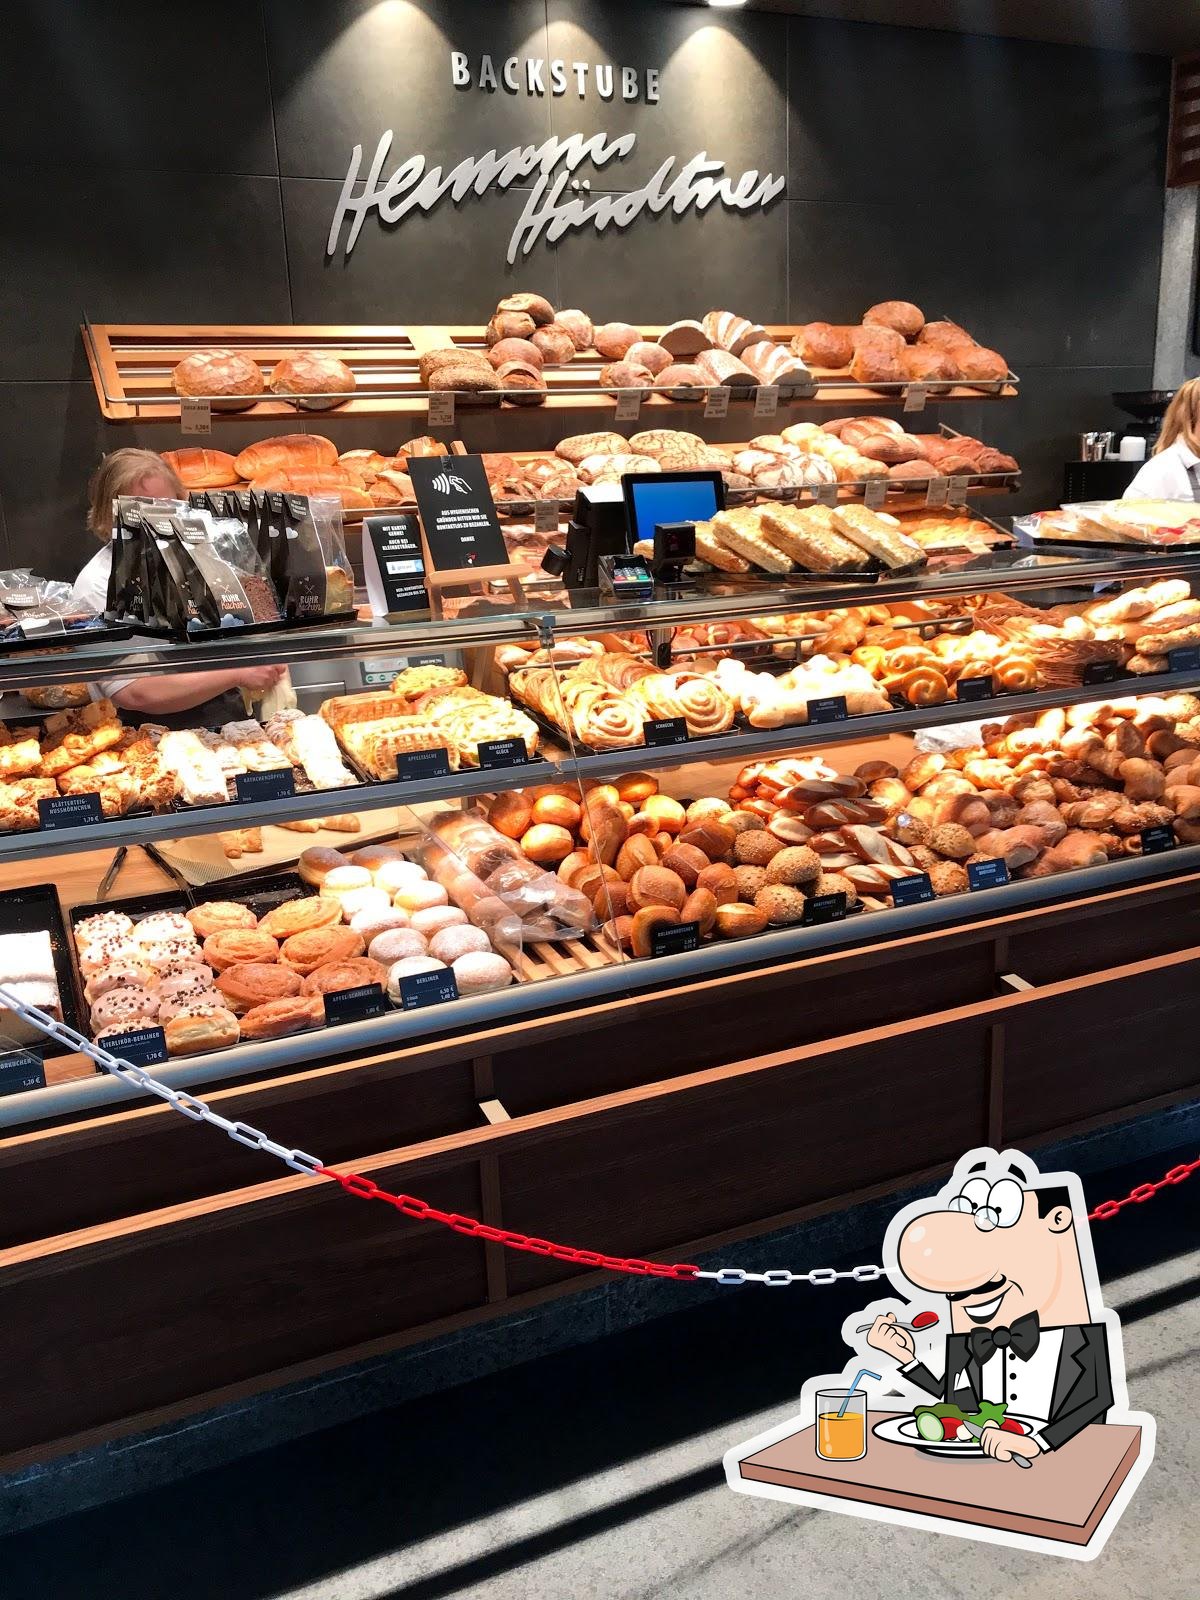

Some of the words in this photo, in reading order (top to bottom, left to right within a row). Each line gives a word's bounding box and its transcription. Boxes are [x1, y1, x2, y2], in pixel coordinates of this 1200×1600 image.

[451, 51, 660, 101] BACKSTUBE
[327, 129, 636, 256] Hermann
[51, 799, 87, 808] BLÄTTERTEIG-
[50, 804, 91, 814] NUSSHÖRNCHEN
[416, 974, 439, 984] BERLINER
[103, 1032, 160, 1048] EIERLIKÖR-BERLINER
[22, 1078, 35, 1086] 1,20
